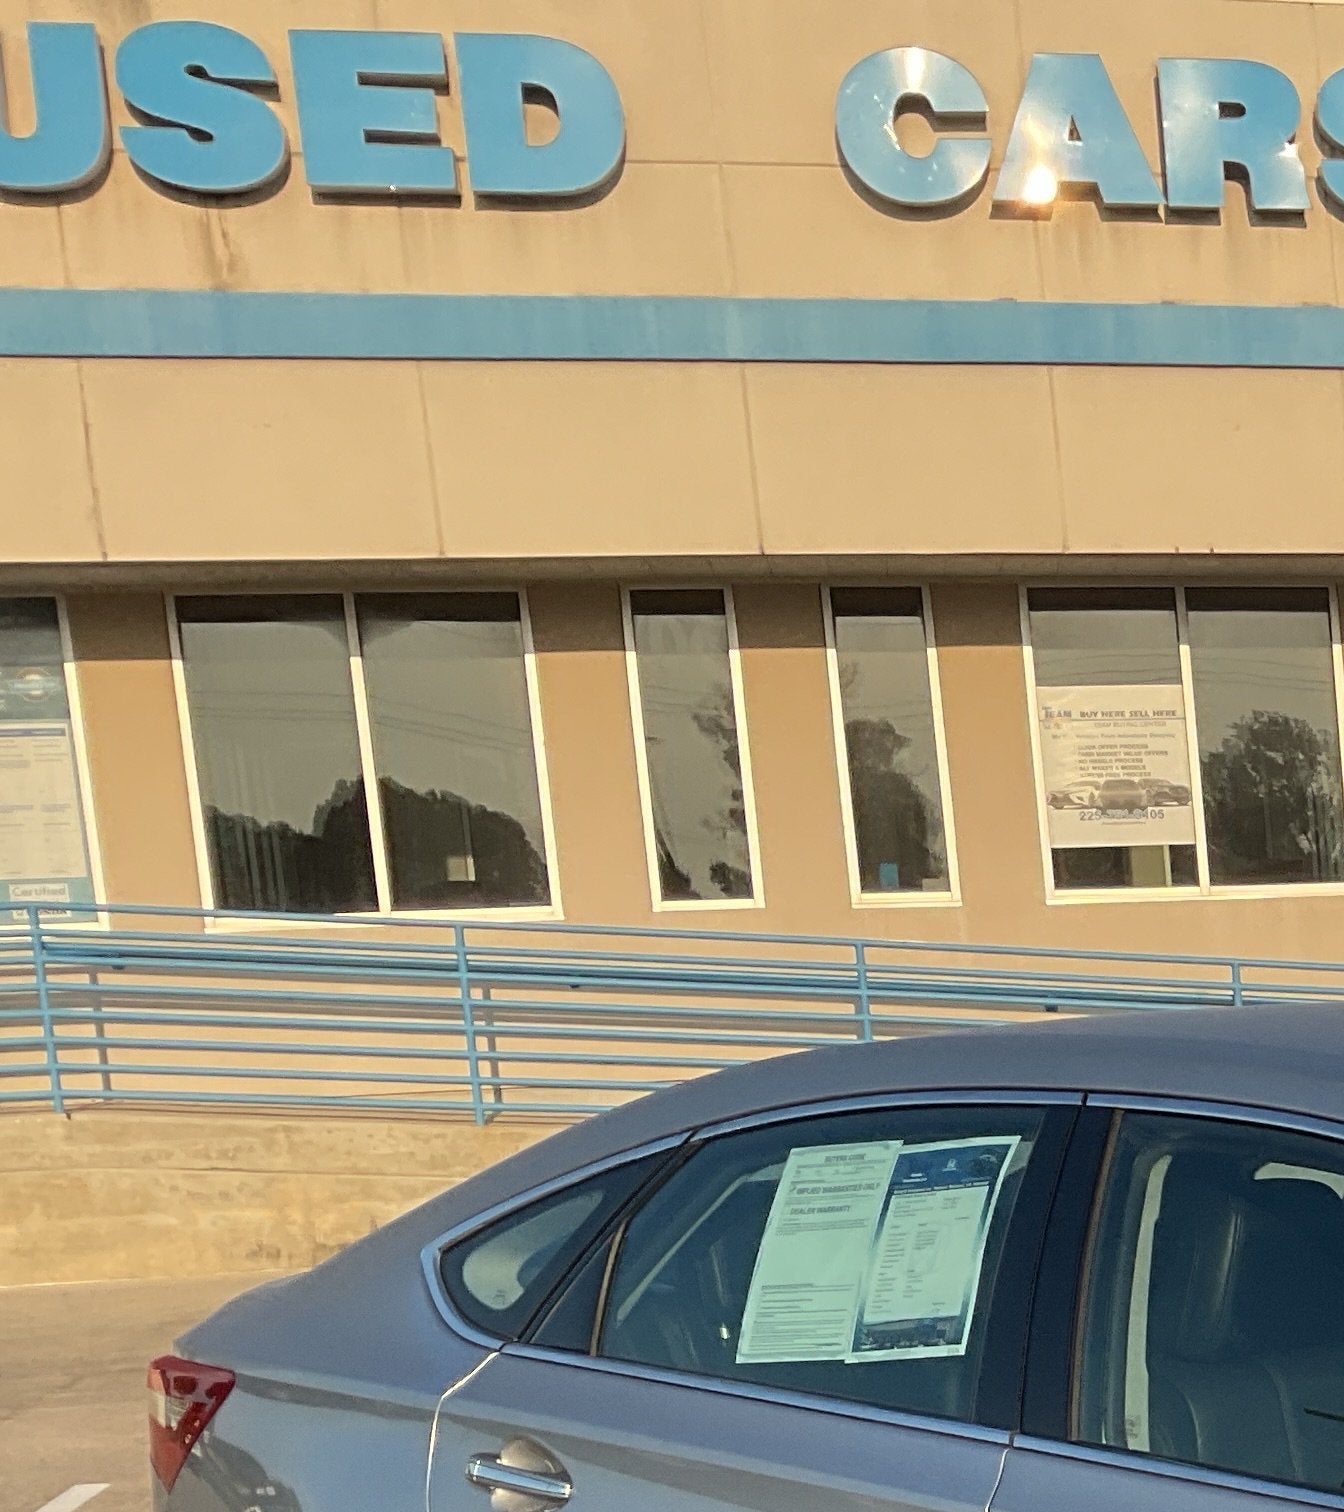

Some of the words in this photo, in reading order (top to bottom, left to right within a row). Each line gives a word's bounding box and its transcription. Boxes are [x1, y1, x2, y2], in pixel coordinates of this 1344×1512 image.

[0, 21, 627, 207] USED
[1079, 710, 1098, 718] BUY
[1101, 710, 1126, 718] HERE
[1152, 709, 1177, 717] HERE
